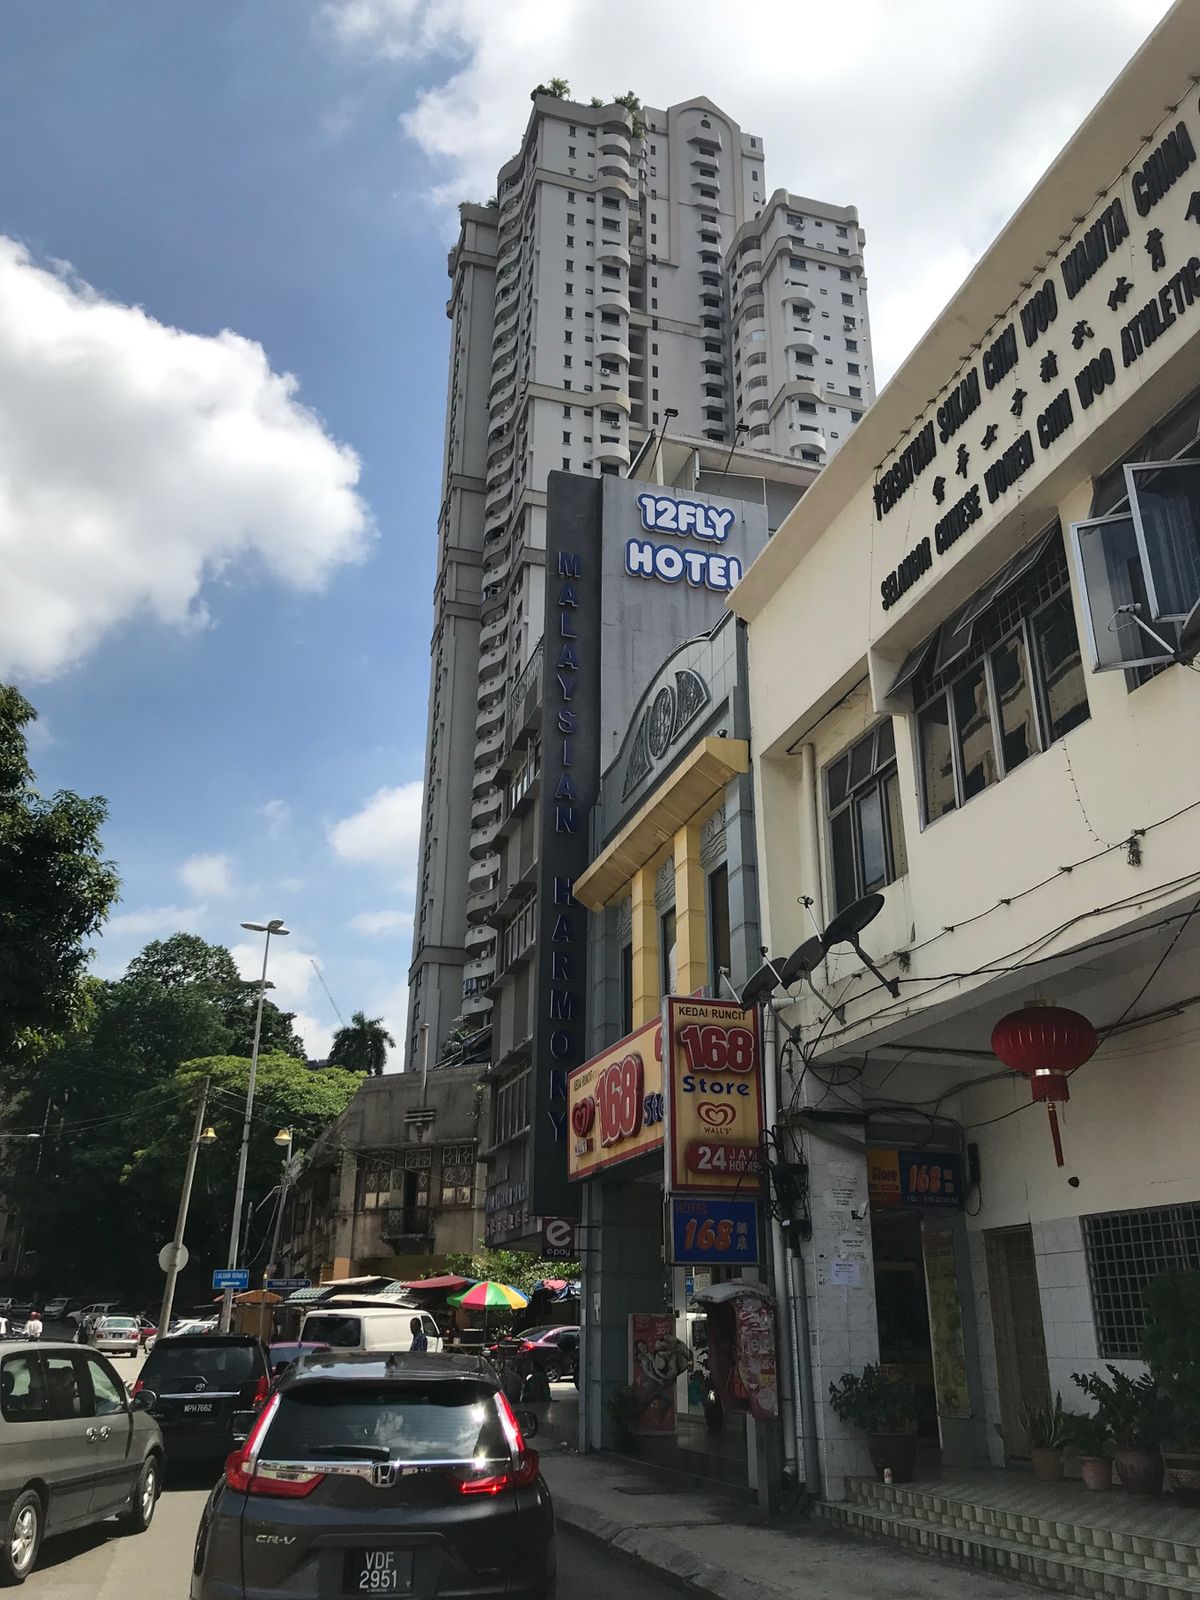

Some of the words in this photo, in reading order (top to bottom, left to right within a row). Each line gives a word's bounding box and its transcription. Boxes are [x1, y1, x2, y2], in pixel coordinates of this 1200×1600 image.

[873, 420, 937, 521] PERSATUAN
[936, 366, 982, 444] SUKAN
[982, 322, 1019, 390] CHIN
[1020, 278, 1059, 348] WOO
[1060, 197, 1130, 300] WANITA
[1131, 120, 1197, 218] CHINA
[880, 536, 933, 611] SELANGOR
[934, 483, 983, 556] CHINESE
[984, 429, 1035, 505] WOMEN
[1036, 387, 1074, 450] CHIN
[1074, 346, 1116, 410] WOO
[637, 493, 735, 543] 12FLY
[555, 551, 580, 834] MALAYSIAN
[547, 876, 576, 1143] HARMONY
[678, 1006, 709, 1018] KEDAI
[711, 1008, 747, 1021] RUNCIT
[680, 1024, 755, 1072] 168
[682, 1075, 750, 1096] Store
[594, 1054, 644, 1148] 168
[703, 1127, 730, 1135] WALL'S
[697, 1146, 727, 1170] 24
[872, 1167, 898, 1181] Store
[908, 1164, 942, 1193] 168
[684, 1217, 735, 1252] 168
[255, 1534, 297, 1545] CR-V
[365, 1551, 395, 1570] VDF
[359, 1569, 397, 1589] 2951
